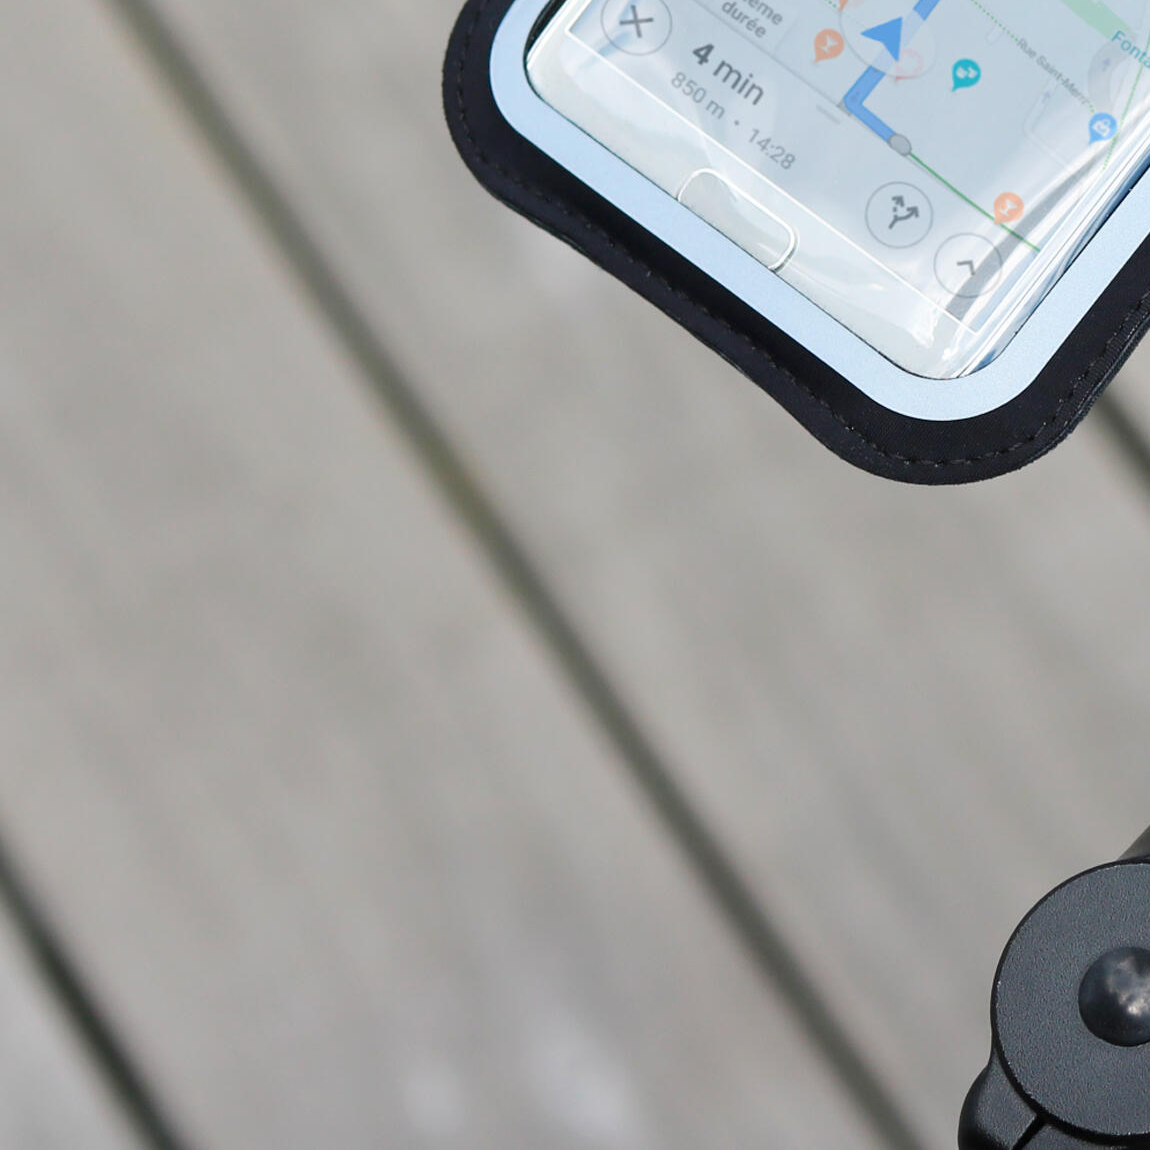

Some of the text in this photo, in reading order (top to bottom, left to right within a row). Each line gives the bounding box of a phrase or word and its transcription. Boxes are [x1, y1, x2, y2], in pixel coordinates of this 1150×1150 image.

[721, 0, 767, 39] durée
[1016, 38, 1037, 59] Rue
[692, 43, 765, 107] 4 min
[670, 71, 796, 171] 850 m 14:28
